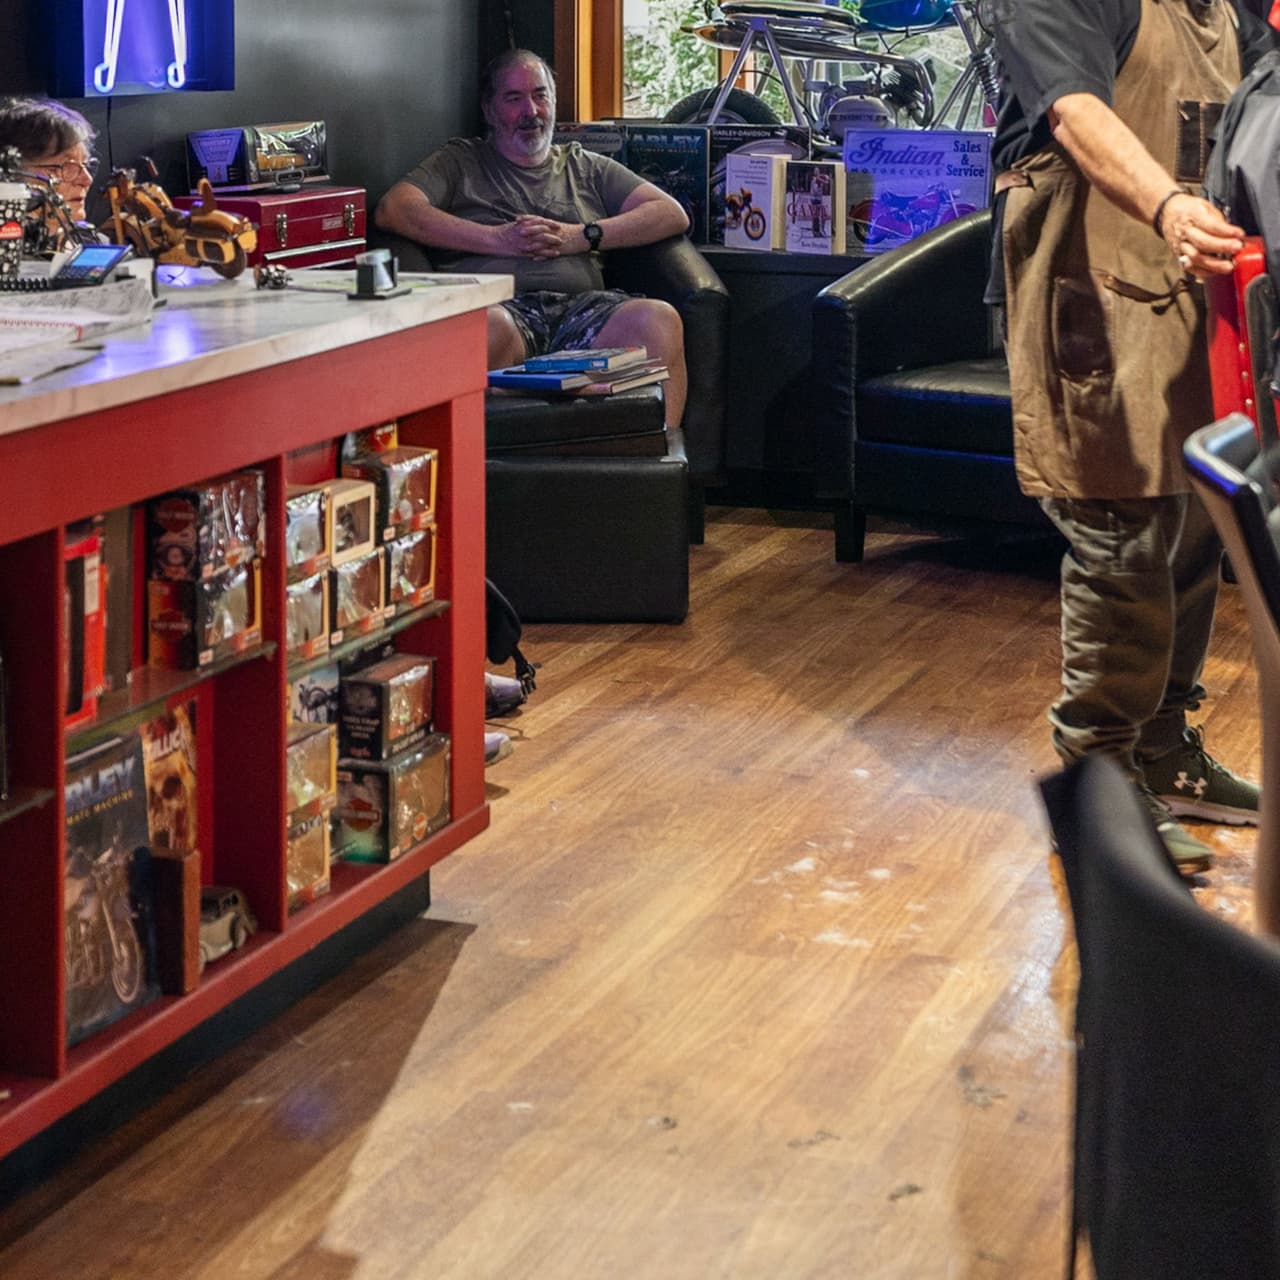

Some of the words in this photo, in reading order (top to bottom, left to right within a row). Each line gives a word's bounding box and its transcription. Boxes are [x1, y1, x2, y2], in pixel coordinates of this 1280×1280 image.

[632, 134, 702, 150] ARLEY
[953, 140, 982, 153] Sales
[849, 137, 947, 166] Indian
[961, 154, 969, 165] &
[946, 165, 985, 177] Service
[65, 756, 135, 815] RLEY
